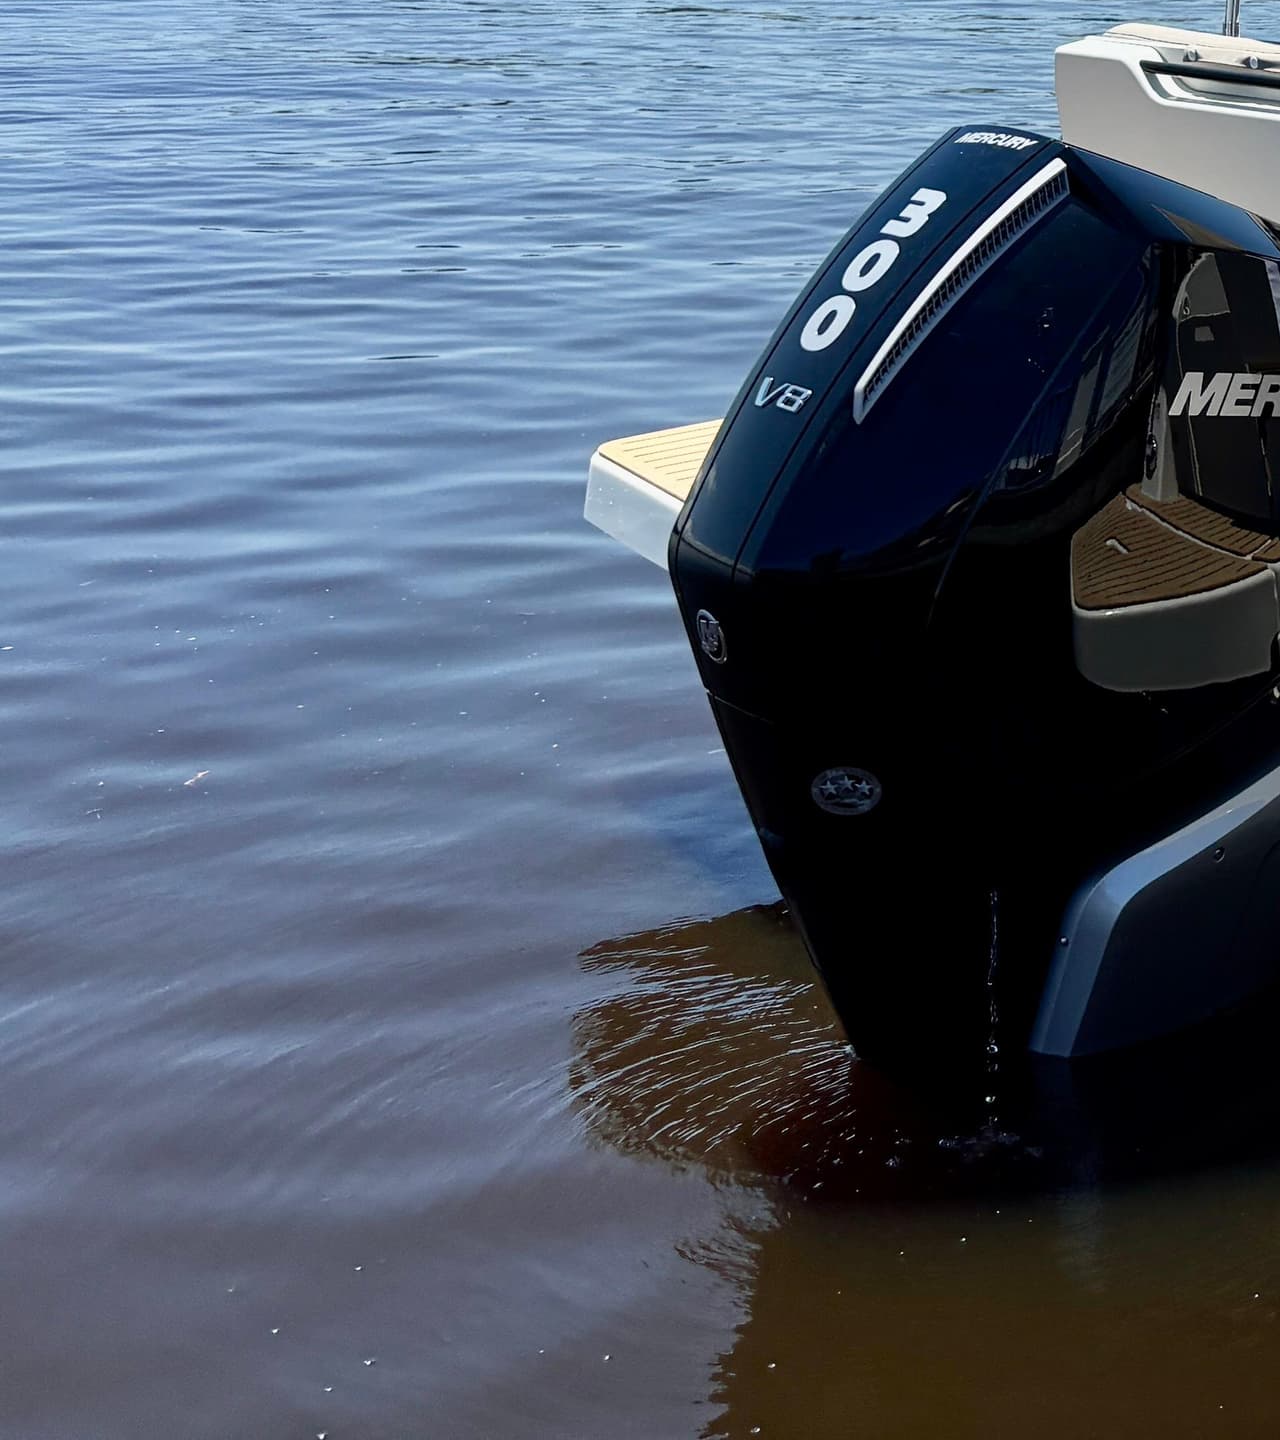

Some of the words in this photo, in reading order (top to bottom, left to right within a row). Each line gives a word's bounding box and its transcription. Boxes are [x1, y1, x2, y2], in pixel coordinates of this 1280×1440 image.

[954, 131, 1039, 150] MERCURY
[800, 187, 947, 352] 300
[754, 376, 813, 413] V8
